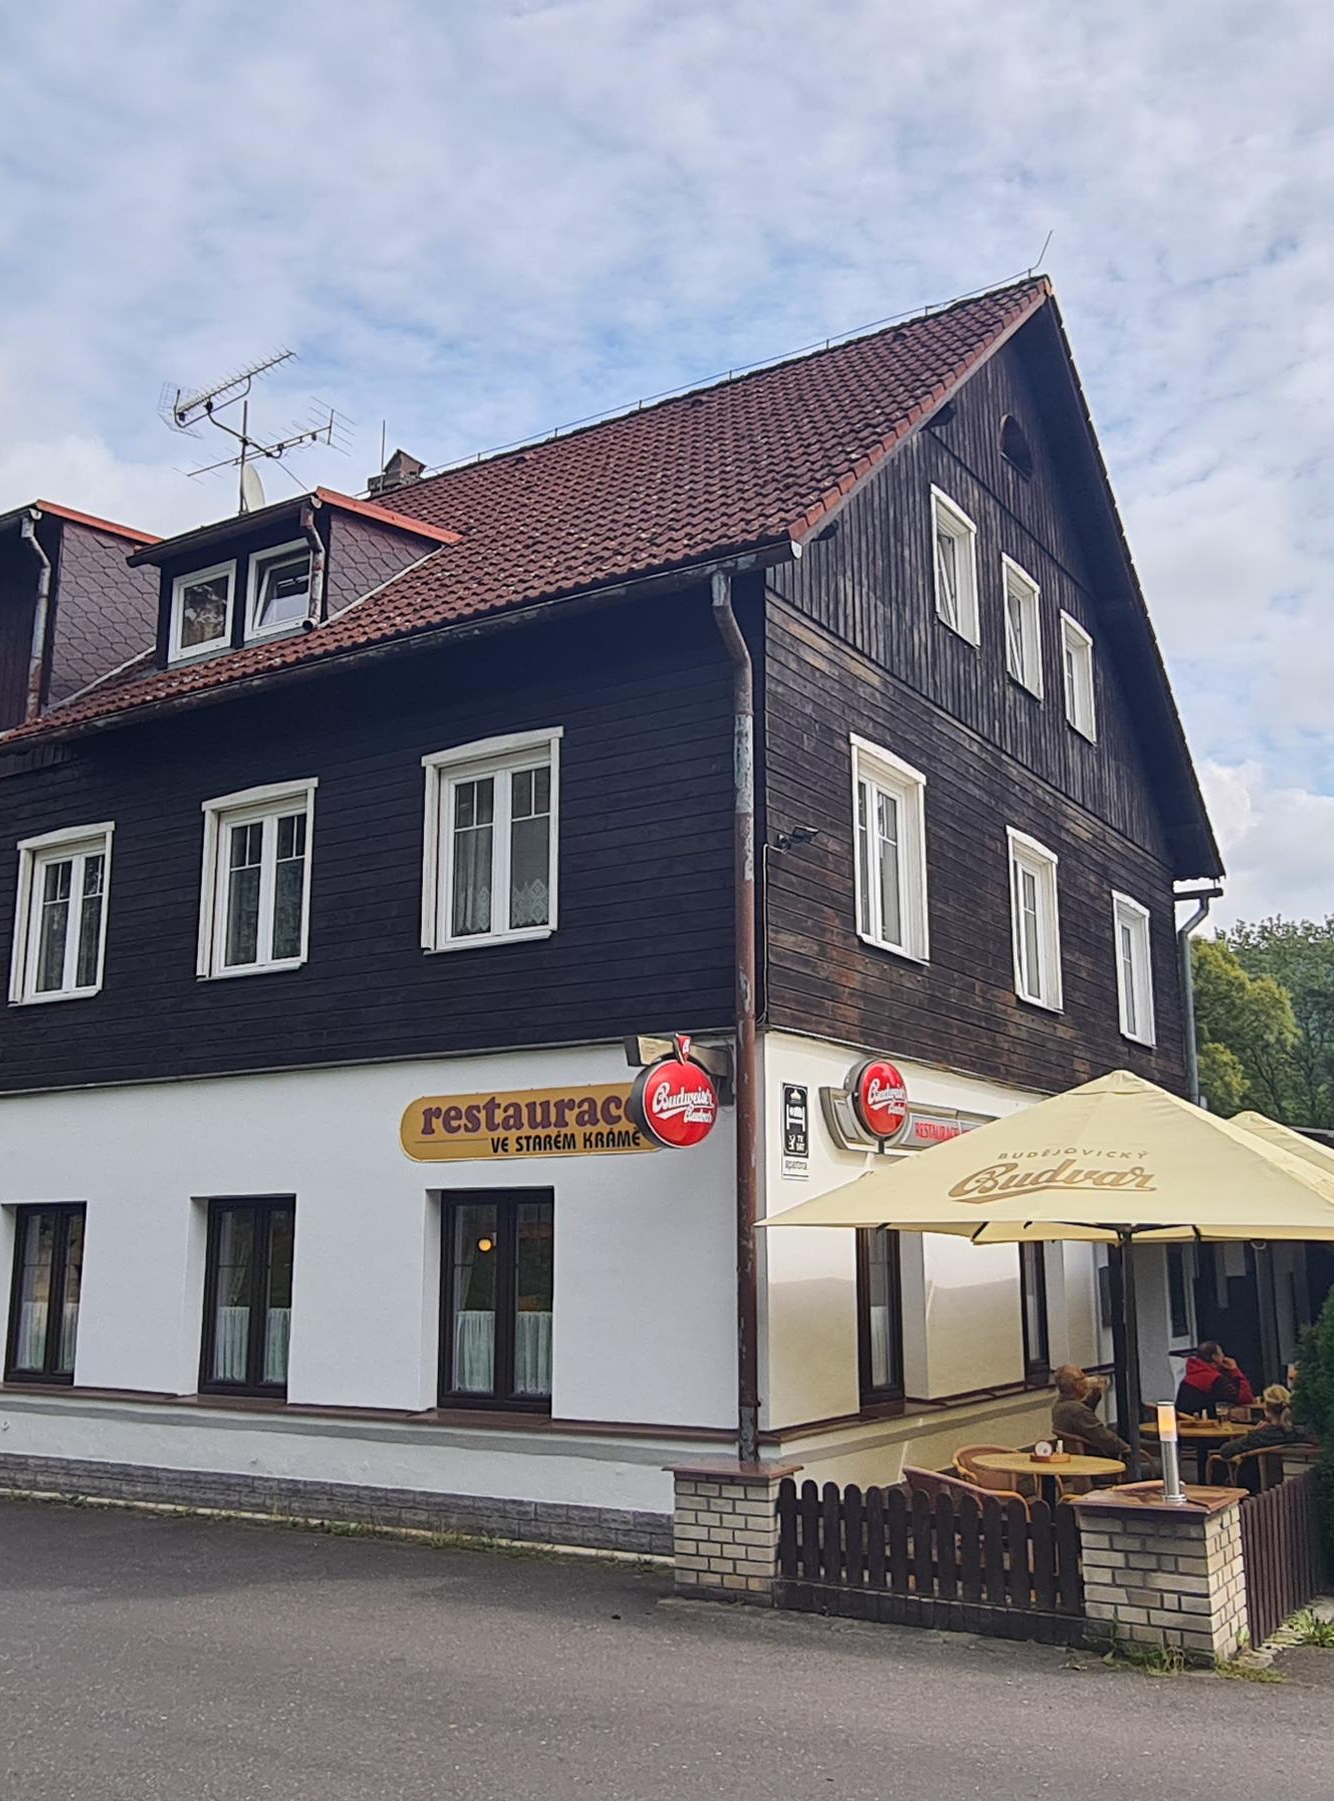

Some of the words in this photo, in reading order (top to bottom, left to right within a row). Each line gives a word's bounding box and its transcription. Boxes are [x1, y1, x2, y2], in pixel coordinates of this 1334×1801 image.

[491, 1137, 509, 1153] VE
[515, 1131, 576, 1152] STARÉM
[998, 1147, 1149, 1160] BUDĚJOVICKÝ
[948, 1158, 1157, 1201] Budvar
